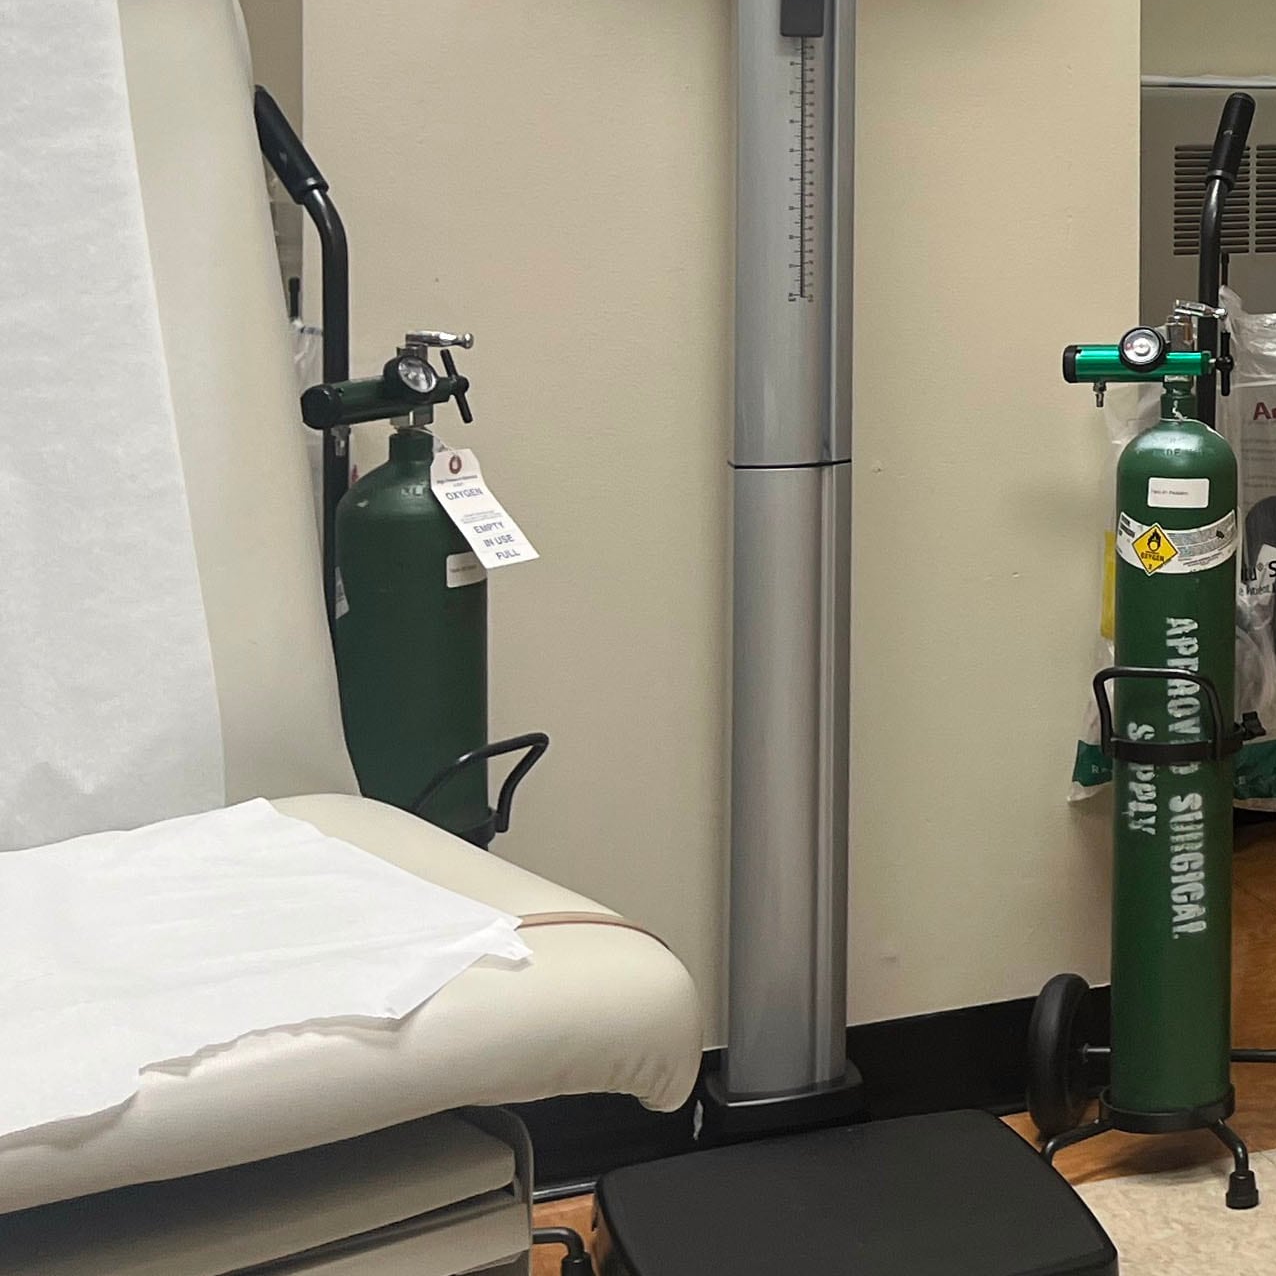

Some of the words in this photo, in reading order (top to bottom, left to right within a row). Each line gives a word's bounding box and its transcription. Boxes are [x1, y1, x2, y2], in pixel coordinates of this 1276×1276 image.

[445, 488, 483, 500] OXYGEN
[473, 522, 504, 533] EMPTY
[483, 539, 494, 547] IN
[496, 534, 515, 544] USE
[496, 549, 521, 560] FULL
[1166, 617, 1201, 775] APPROVD
[1126, 722, 1158, 835] SPPLY
